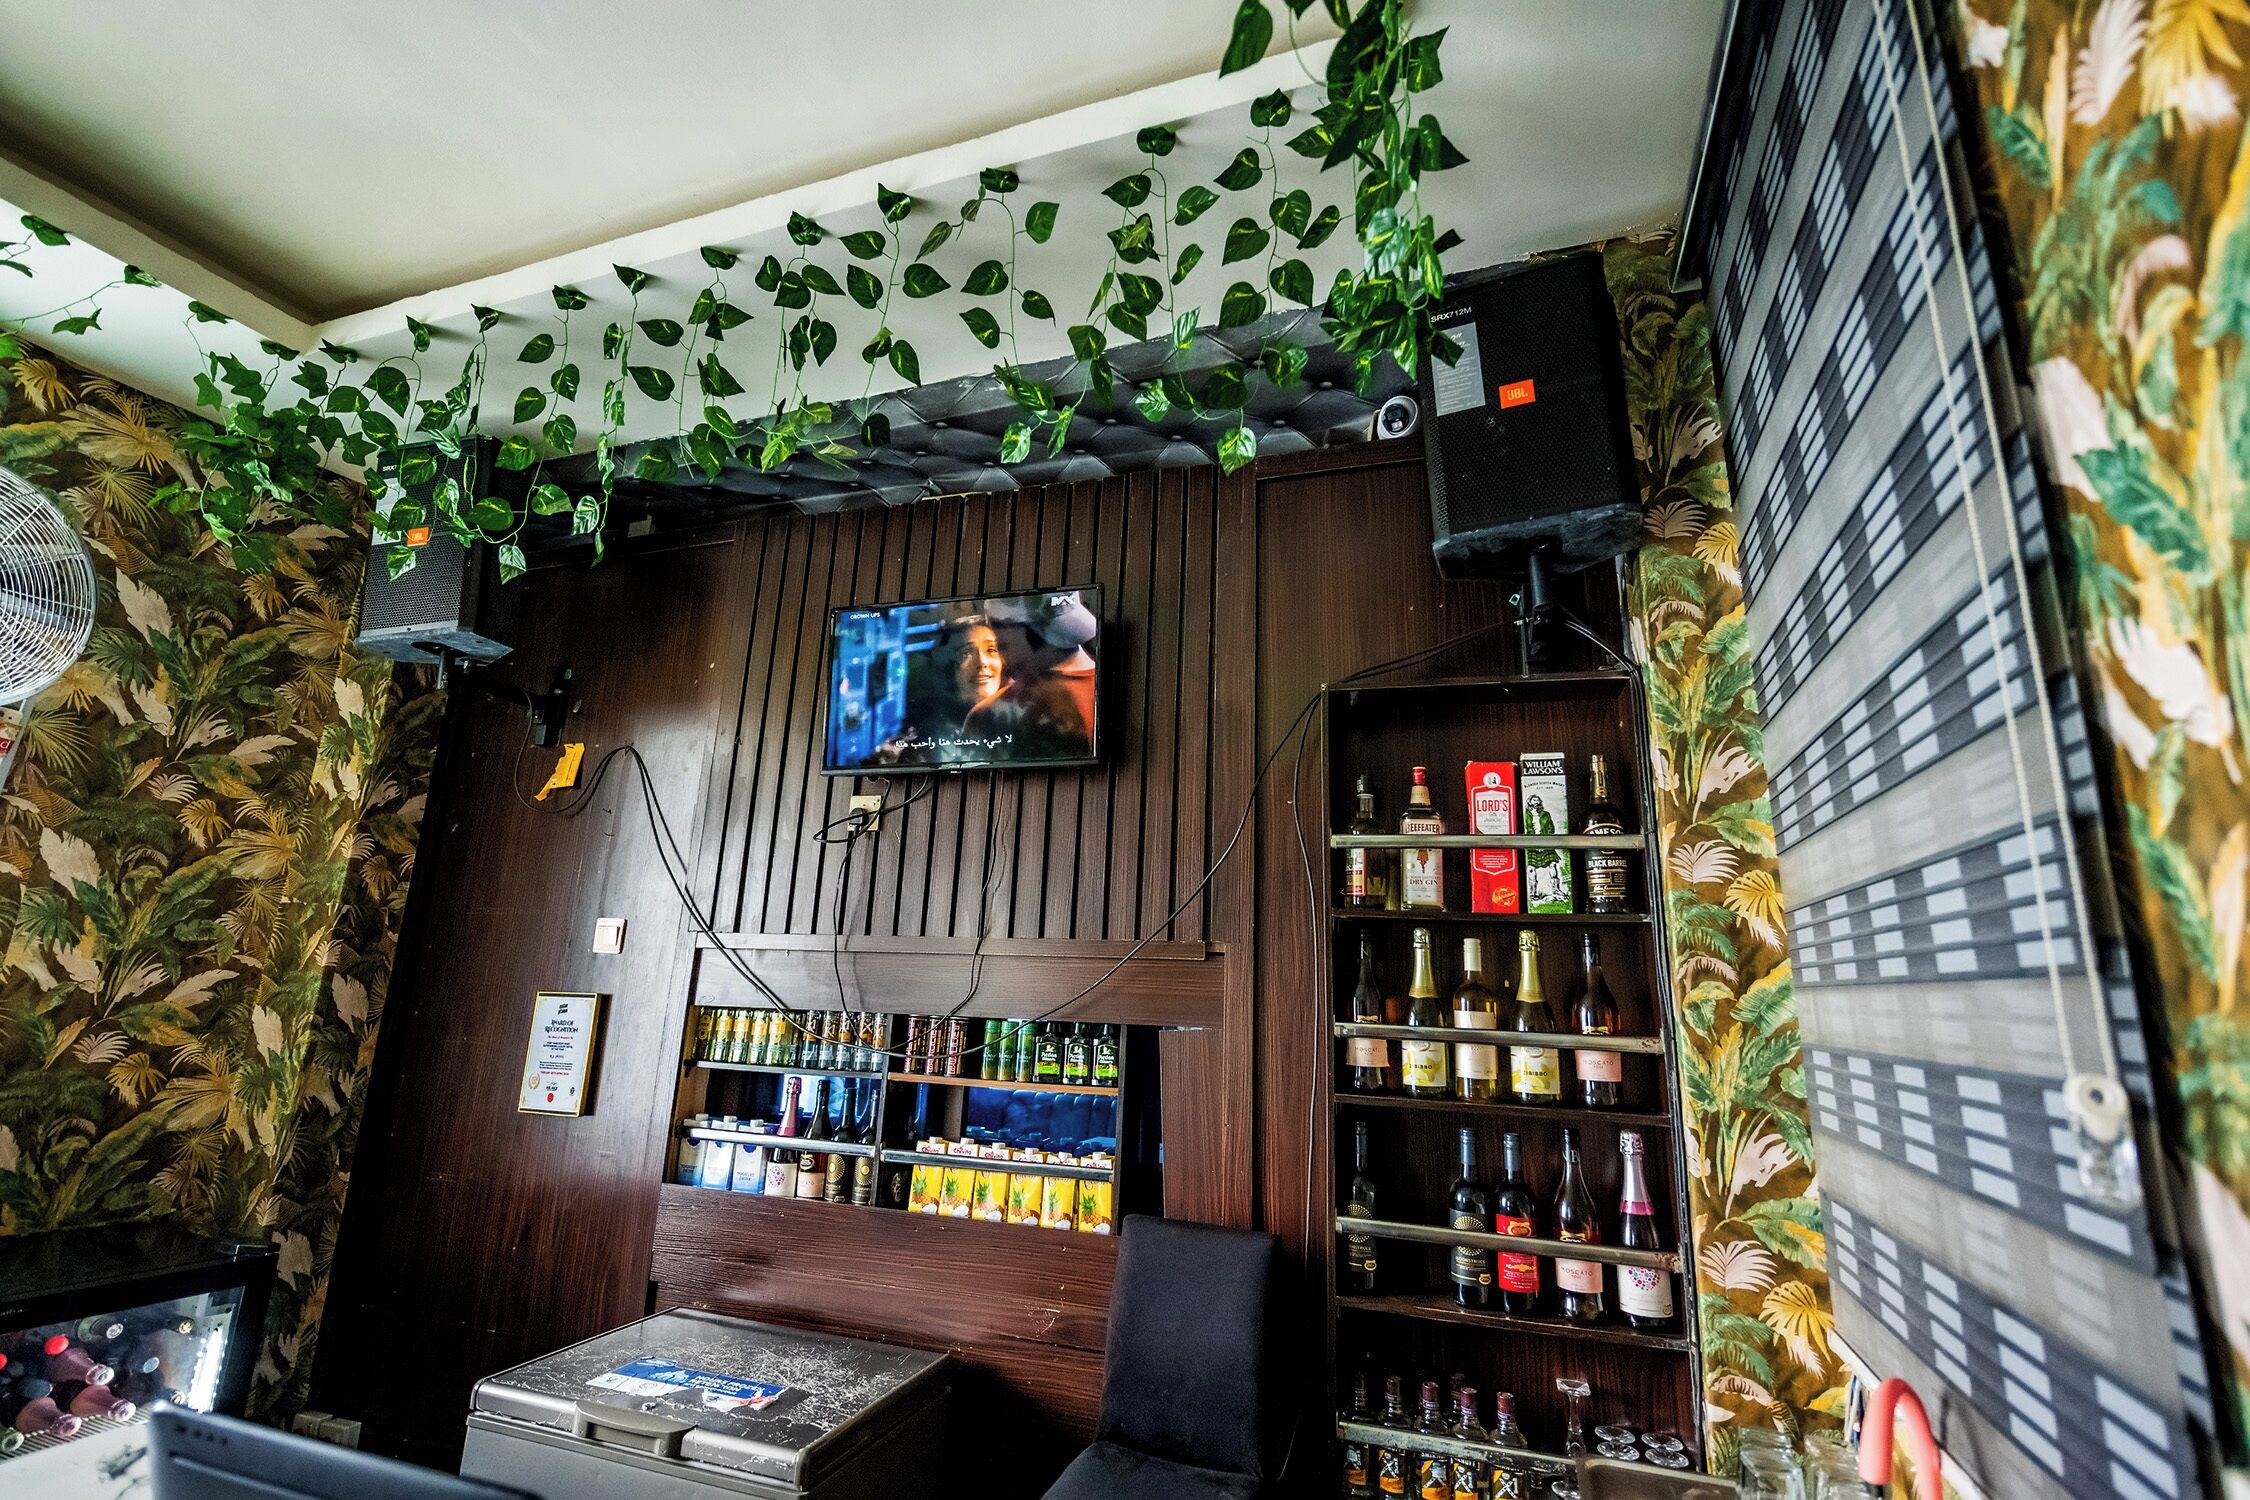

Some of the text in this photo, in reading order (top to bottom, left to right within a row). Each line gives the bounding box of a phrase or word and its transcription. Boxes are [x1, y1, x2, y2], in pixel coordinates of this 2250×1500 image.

[1430, 306, 1472, 323] SRX712M
[1506, 387, 1529, 401] JBL
[382, 464, 398, 472] SRX7
[1524, 760, 1560, 768] WILLIAM
[1523, 766, 1564, 775] LAWSON'S
[1476, 799, 1508, 812] LORD'S
[1405, 823, 1440, 833] BEEFEATER
[1588, 859, 1607, 868] BLACK
[953, 1147, 973, 1155] Chivita
[984, 1151, 1004, 1159] Chivita
[1560, 1266, 1593, 1277] MOSCATO
